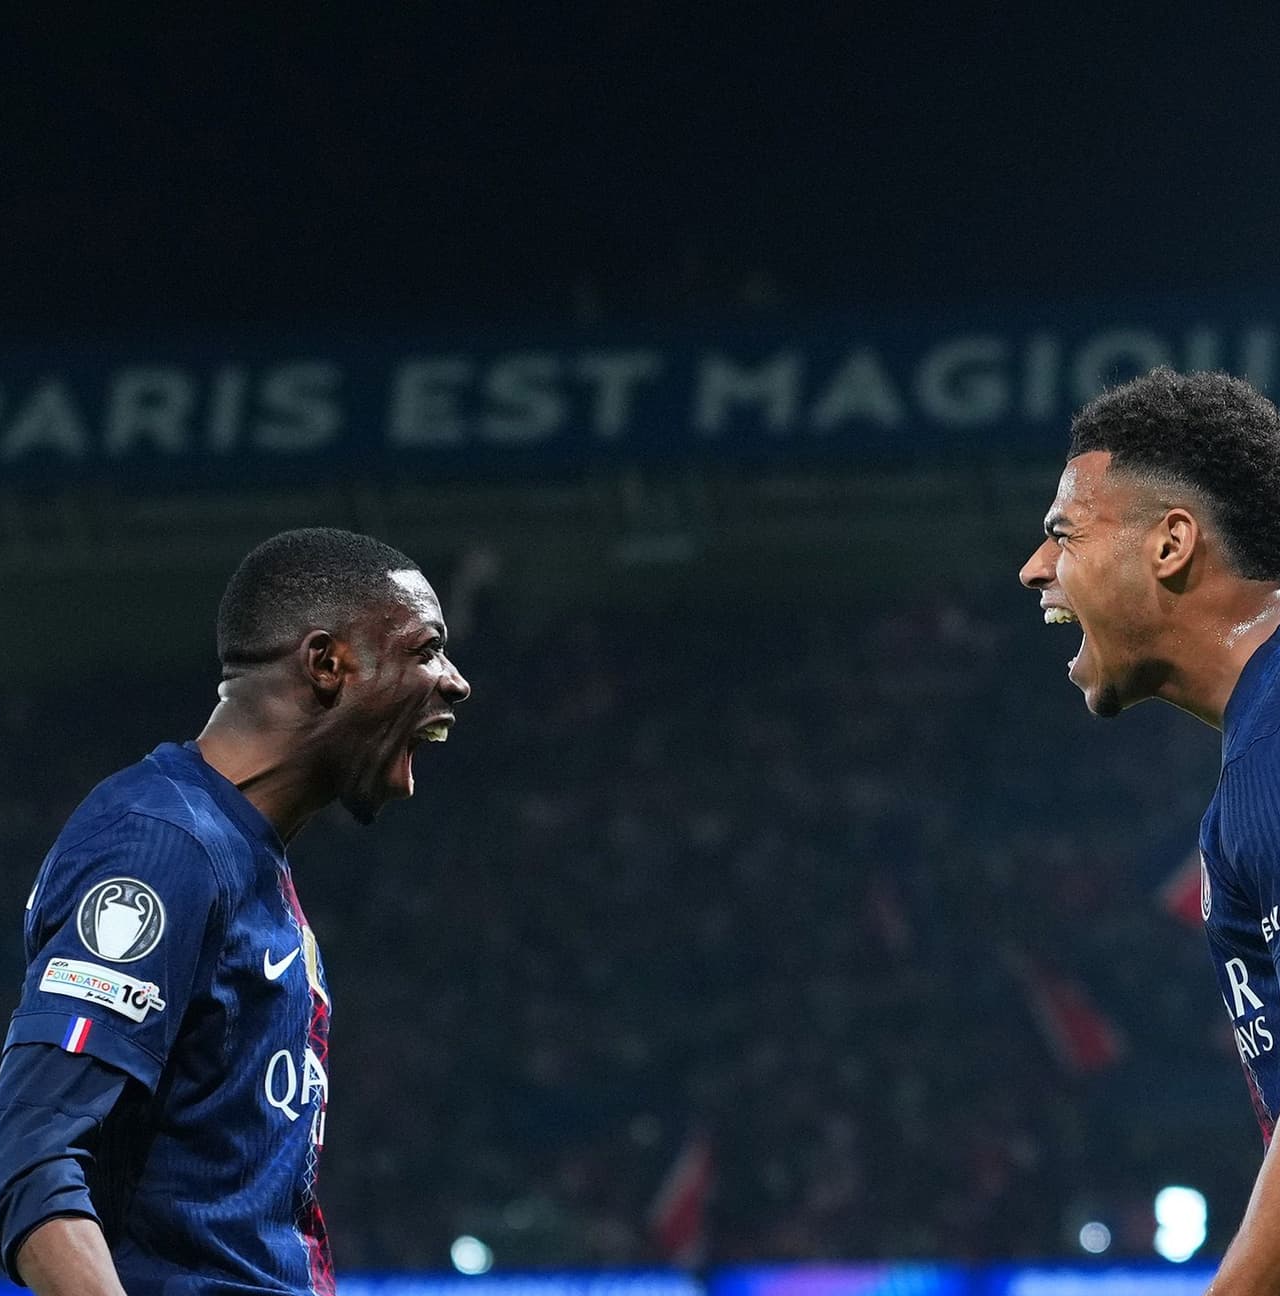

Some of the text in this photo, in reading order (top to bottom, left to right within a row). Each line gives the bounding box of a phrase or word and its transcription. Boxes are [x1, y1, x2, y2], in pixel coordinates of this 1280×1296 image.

[386, 352, 664, 448] EST
[47, 970, 120, 995] FOUNDATION
[122, 984, 148, 1010] 10
